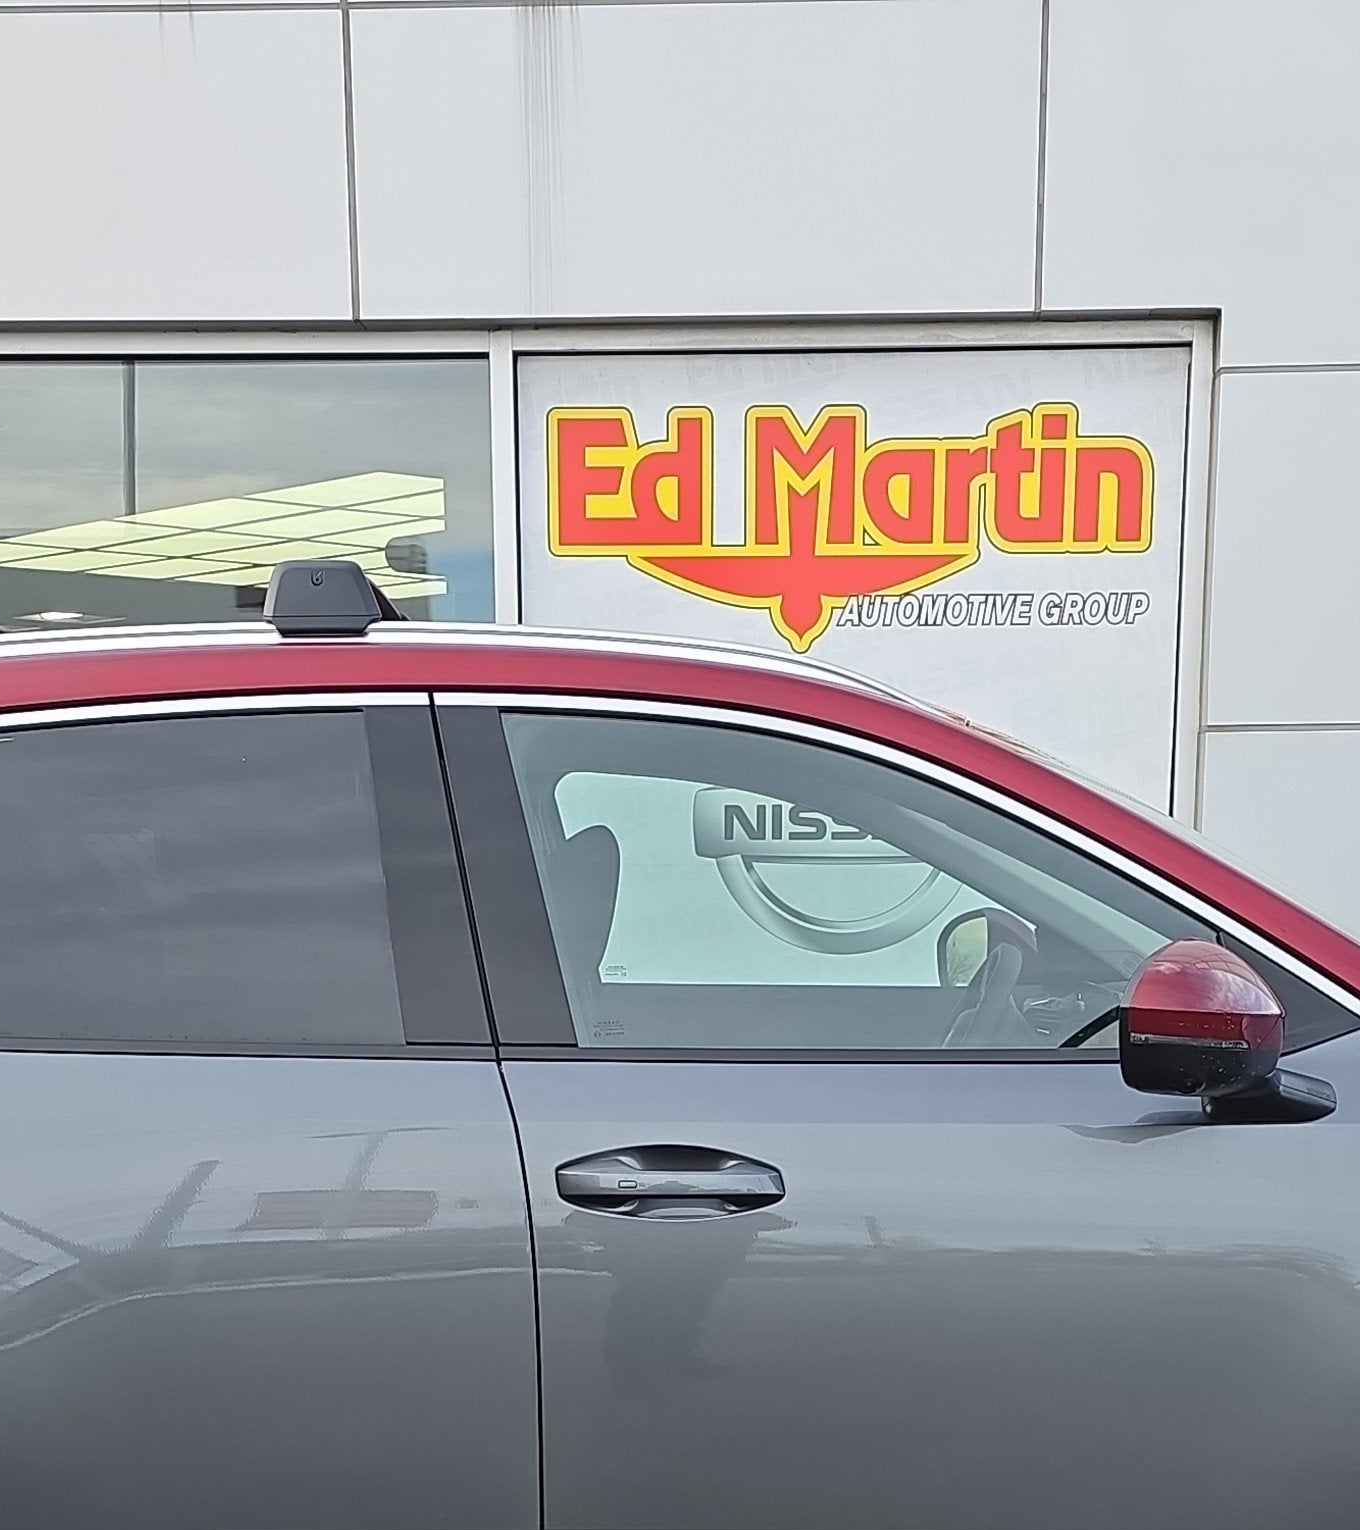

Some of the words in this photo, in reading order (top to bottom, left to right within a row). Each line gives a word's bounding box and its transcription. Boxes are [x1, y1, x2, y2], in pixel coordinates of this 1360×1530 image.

[547, 406, 712, 556] Ed
[746, 403, 1154, 556] Martin
[838, 592, 1035, 627] AUTOMOTIVE
[1038, 591, 1151, 627] GROUP
[724, 804, 880, 841] NISS
